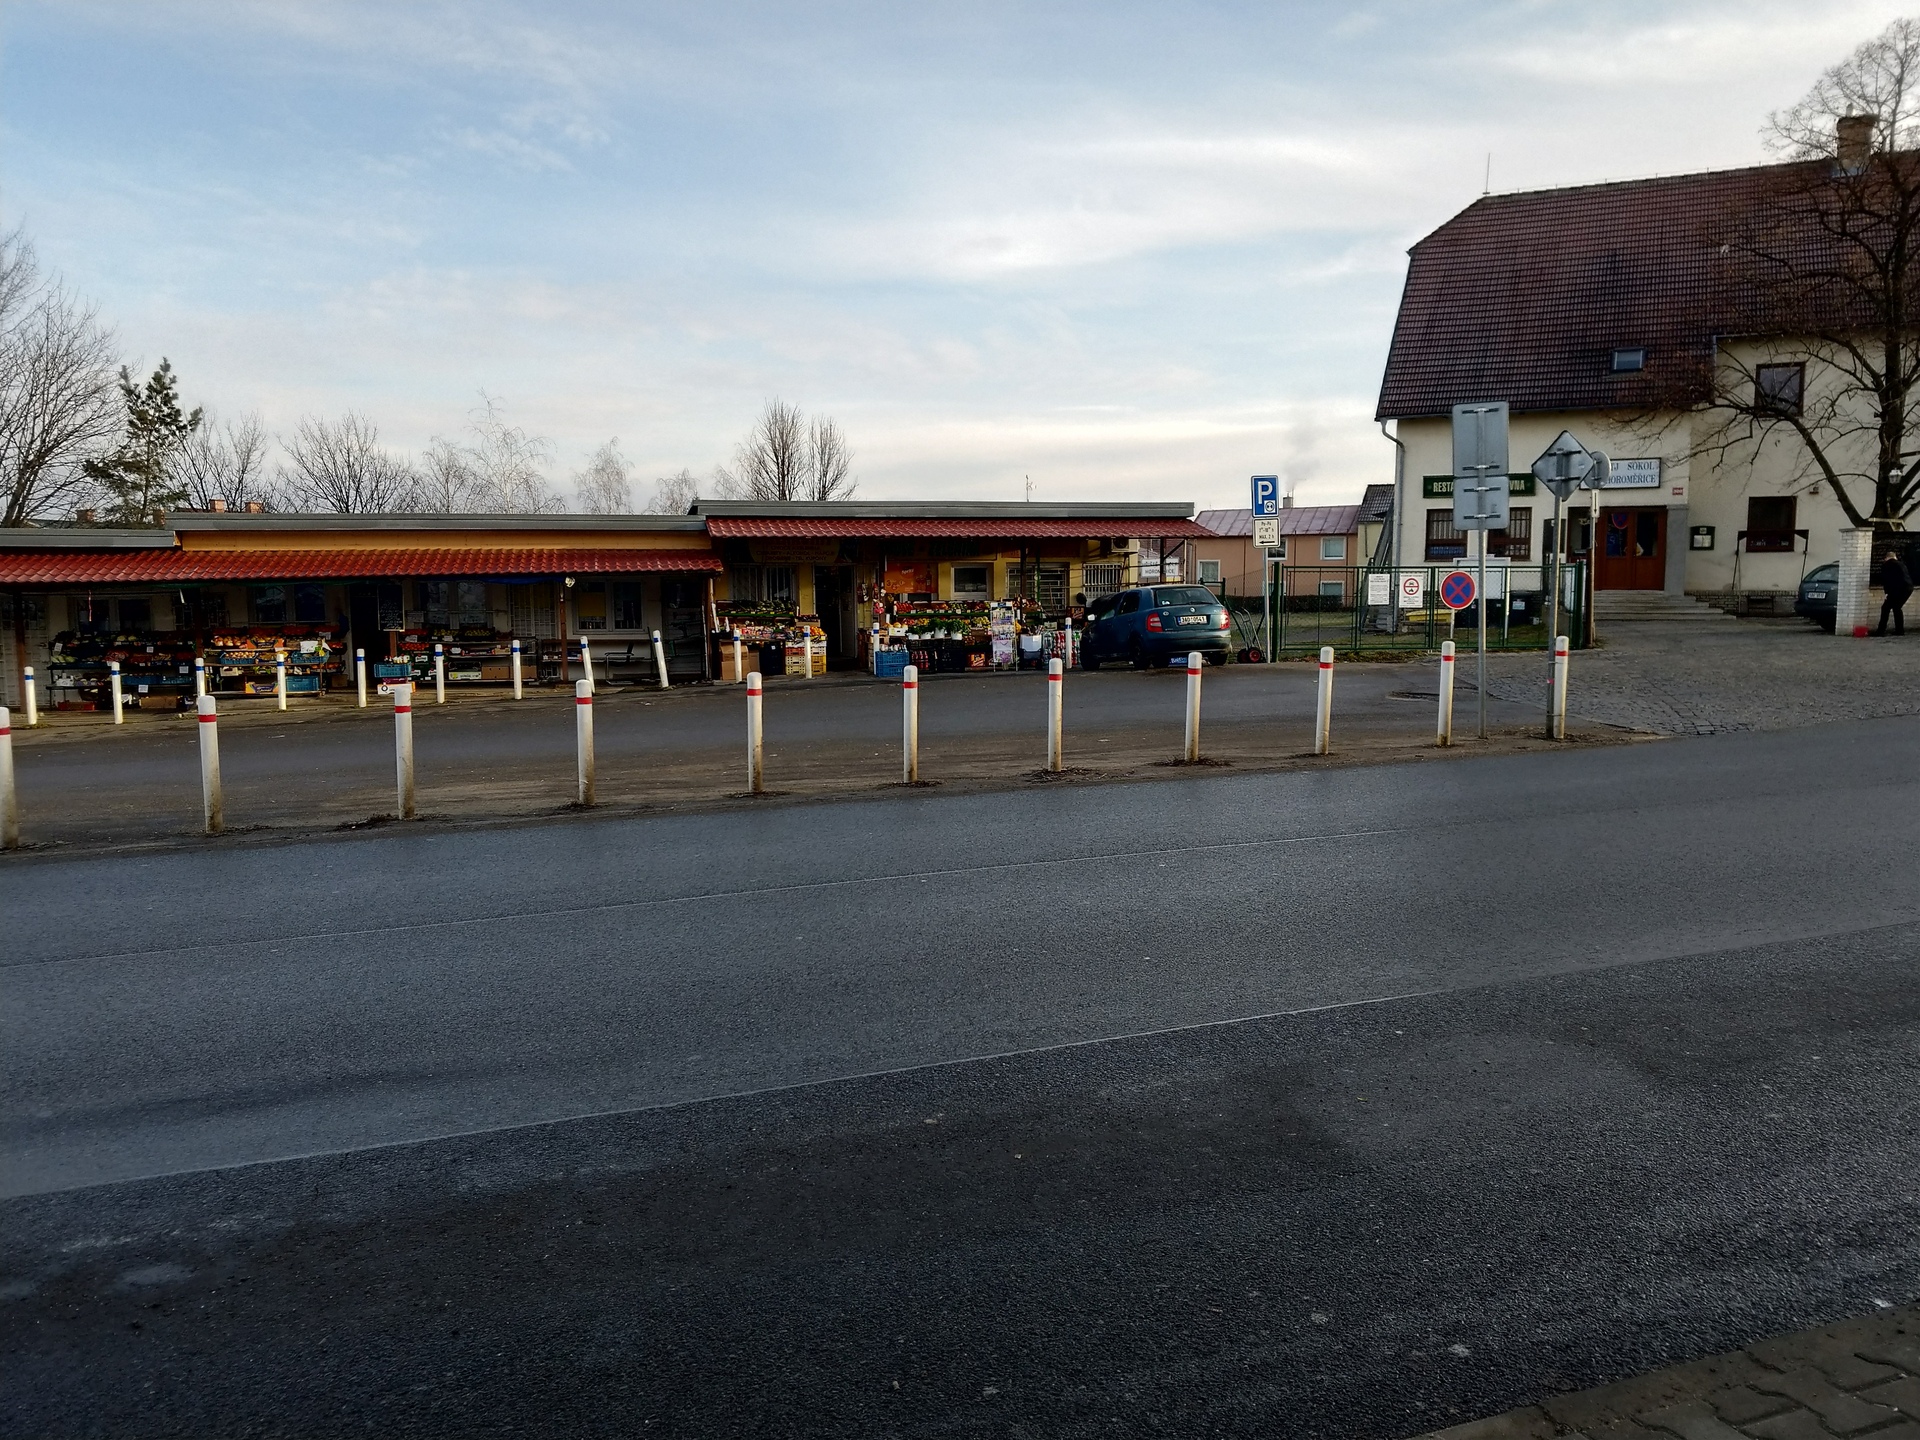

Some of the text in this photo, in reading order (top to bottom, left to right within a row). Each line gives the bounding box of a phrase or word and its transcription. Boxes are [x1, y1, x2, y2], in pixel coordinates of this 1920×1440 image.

[1627, 461, 1655, 471] SOKOL
[1258, 480, 1273, 505] P
[1432, 481, 1454, 493] RESTA
